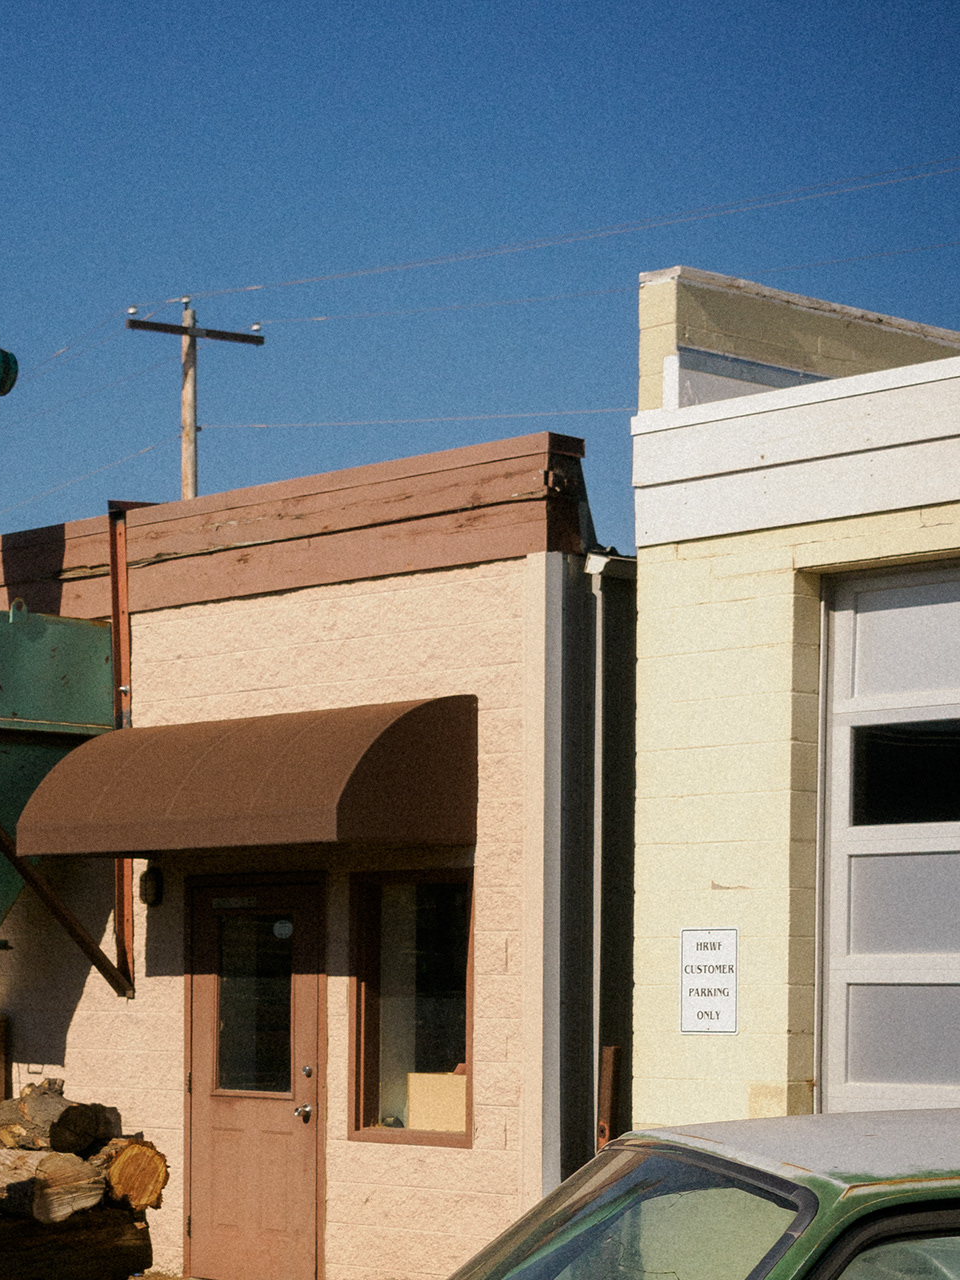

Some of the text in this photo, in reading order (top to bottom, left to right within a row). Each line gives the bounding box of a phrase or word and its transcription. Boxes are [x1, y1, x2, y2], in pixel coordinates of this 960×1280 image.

[684, 964, 735, 974] CUSTOMER
[688, 987, 730, 997] PARKING
[696, 1010, 721, 1020] ONLY
